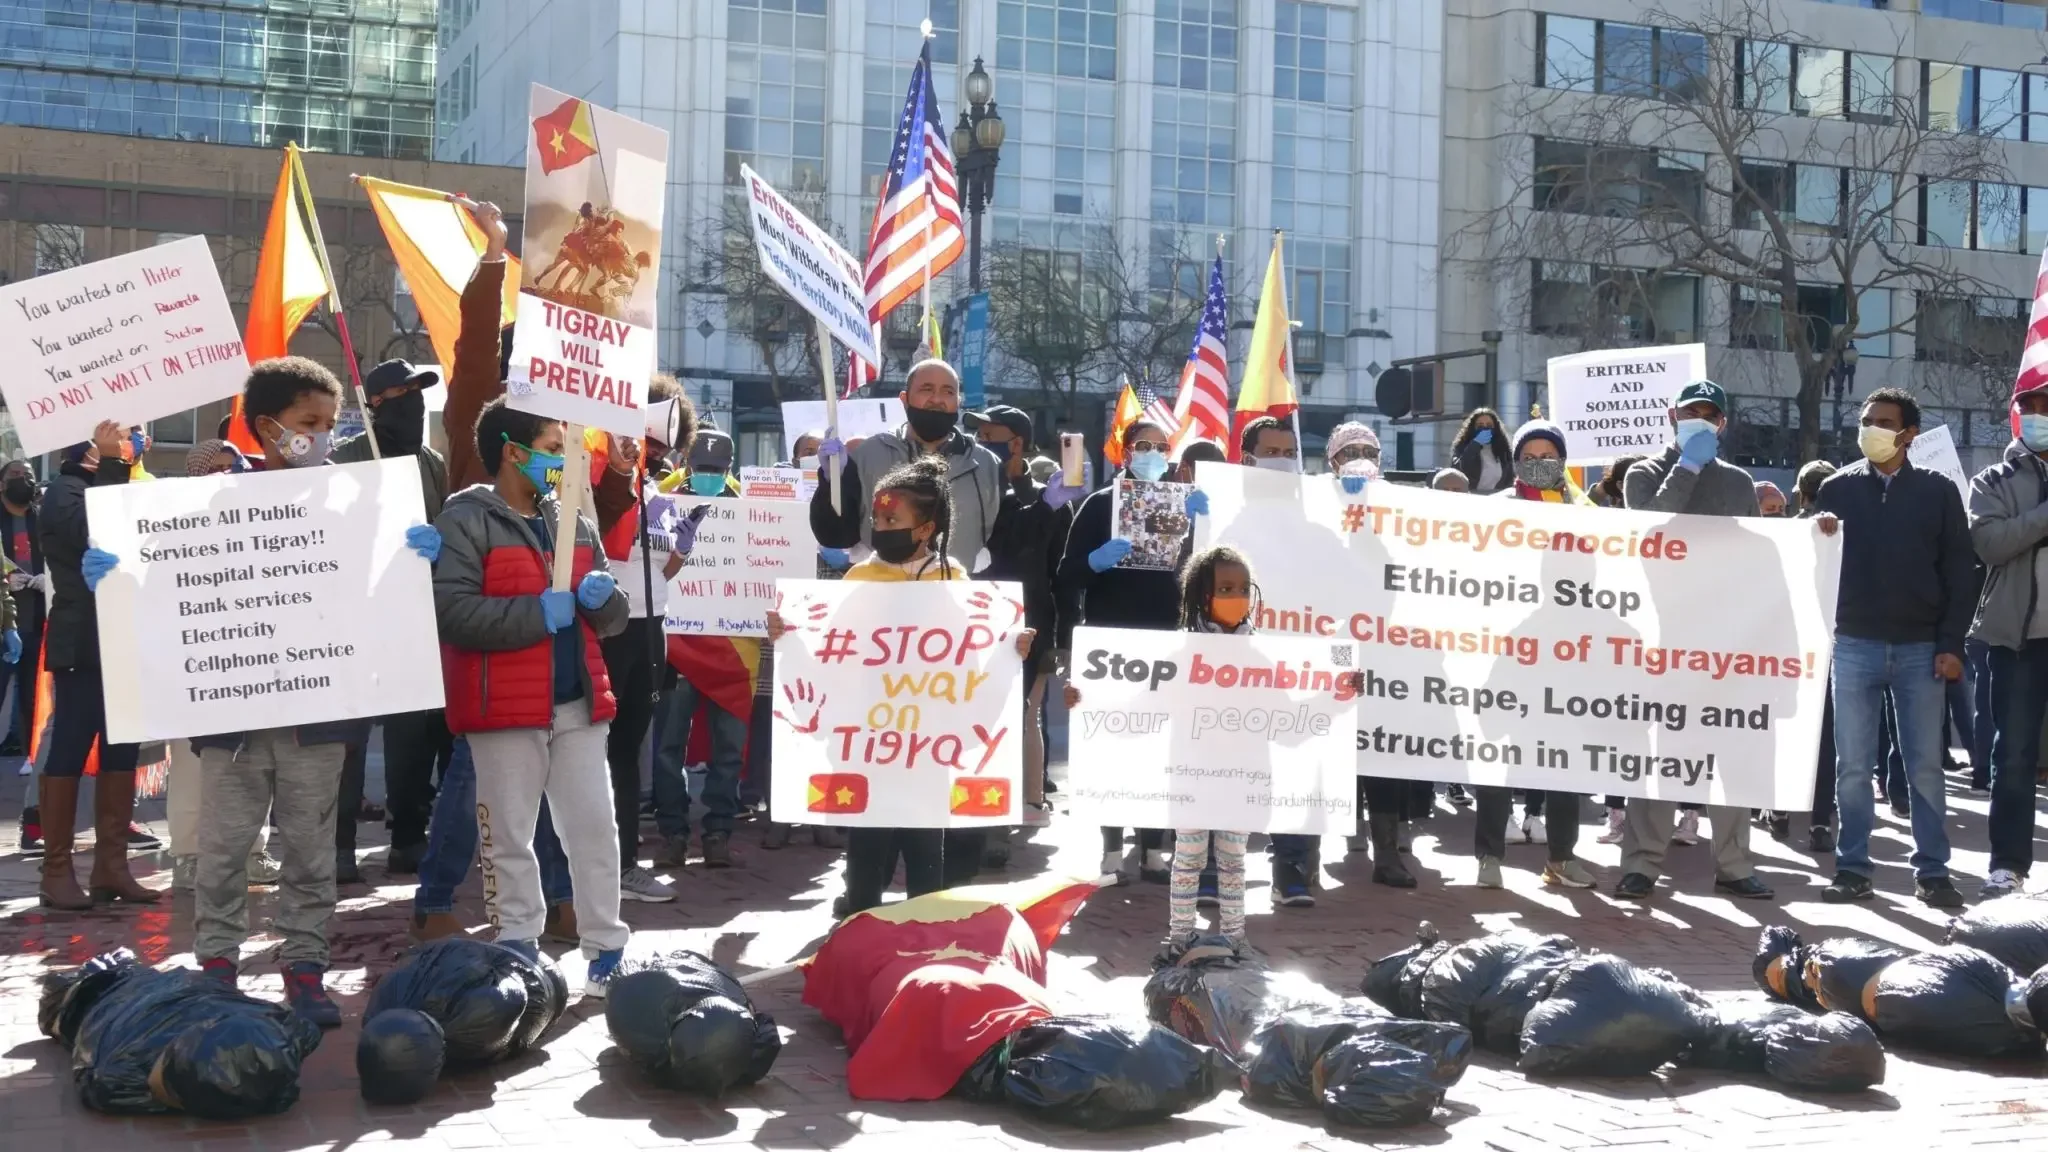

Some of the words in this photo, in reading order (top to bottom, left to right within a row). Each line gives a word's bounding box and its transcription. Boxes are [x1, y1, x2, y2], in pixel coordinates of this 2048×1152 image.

[758, 212, 787, 250] Must
[787, 237, 839, 294] Withdraw
[15, 297, 51, 321] You
[56, 283, 111, 312] waited
[116, 280, 135, 293] on
[141, 266, 182, 286] Hitler
[798, 275, 843, 327] Territory
[32, 336, 62, 356] You
[67, 317, 113, 346] waited
[120, 314, 143, 327] on
[154, 294, 200, 315] Rwanda
[542, 301, 631, 347] TIGRAY
[45, 365, 72, 384] You
[80, 349, 124, 374] waited
[129, 343, 149, 356] on
[164, 326, 204, 343] Sudan
[561, 339, 604, 368] WILL
[1586, 362, 1667, 378] ERITREAN
[26, 397, 55, 420] DO
[60, 380, 93, 408] NOT
[102, 362, 153, 394] WAIT
[162, 355, 184, 377] ON
[529, 356, 638, 409] PREVAIL
[1609, 382, 1644, 394] AND
[1585, 398, 1669, 413] SOMALIAN
[1565, 417, 1629, 432] TROOPS
[1633, 415, 1667, 428] OUT
[1594, 434, 1654, 448] TIGRAY
[774, 475, 799, 484] Tigray
[136, 509, 211, 534] Restore
[217, 508, 241, 526] All
[248, 503, 308, 523] Public
[722, 510, 735, 520] on
[749, 508, 784, 524] Hitler
[1341, 503, 1689, 561] #TigrayGenocide
[139, 538, 220, 563] Services
[226, 536, 244, 554] in
[250, 529, 326, 553] Tigray!!
[721, 535, 735, 543] on
[748, 532, 791, 547] Rwanda
[175, 564, 255, 588] Hospital
[261, 557, 339, 579] services
[723, 557, 735, 566] on
[746, 555, 783, 567] Sudan
[179, 596, 228, 616] Bank
[234, 587, 312, 611] services
[678, 580, 717, 597] WAIT
[724, 581, 737, 597] ON
[1384, 563, 1539, 606] Ethiopia
[1554, 579, 1641, 617] Stop
[181, 620, 277, 645] Electricity
[1255, 601, 1336, 637] hnic
[1350, 613, 1539, 666] Cleansing
[1553, 634, 1593, 662] of
[1606, 636, 1815, 680] Tigrayans!
[184, 649, 280, 675] Cellphone
[285, 642, 355, 663] Service
[1082, 648, 1178, 692] Stop
[1188, 653, 1358, 702] bombing
[186, 673, 331, 702] Transportation
[881, 669, 991, 704] war
[1364, 669, 1409, 700] he
[1423, 675, 1529, 718] Rape,
[1544, 687, 1687, 732] Looting
[1700, 703, 1769, 731] and
[867, 702, 921, 731] on
[1082, 709, 1169, 739] your
[1191, 704, 1331, 741] people
[1357, 724, 1522, 766] struction
[1536, 740, 1569, 769] in
[1582, 743, 1715, 787] Tigray!
[476, 803, 497, 906] GOLDEN
